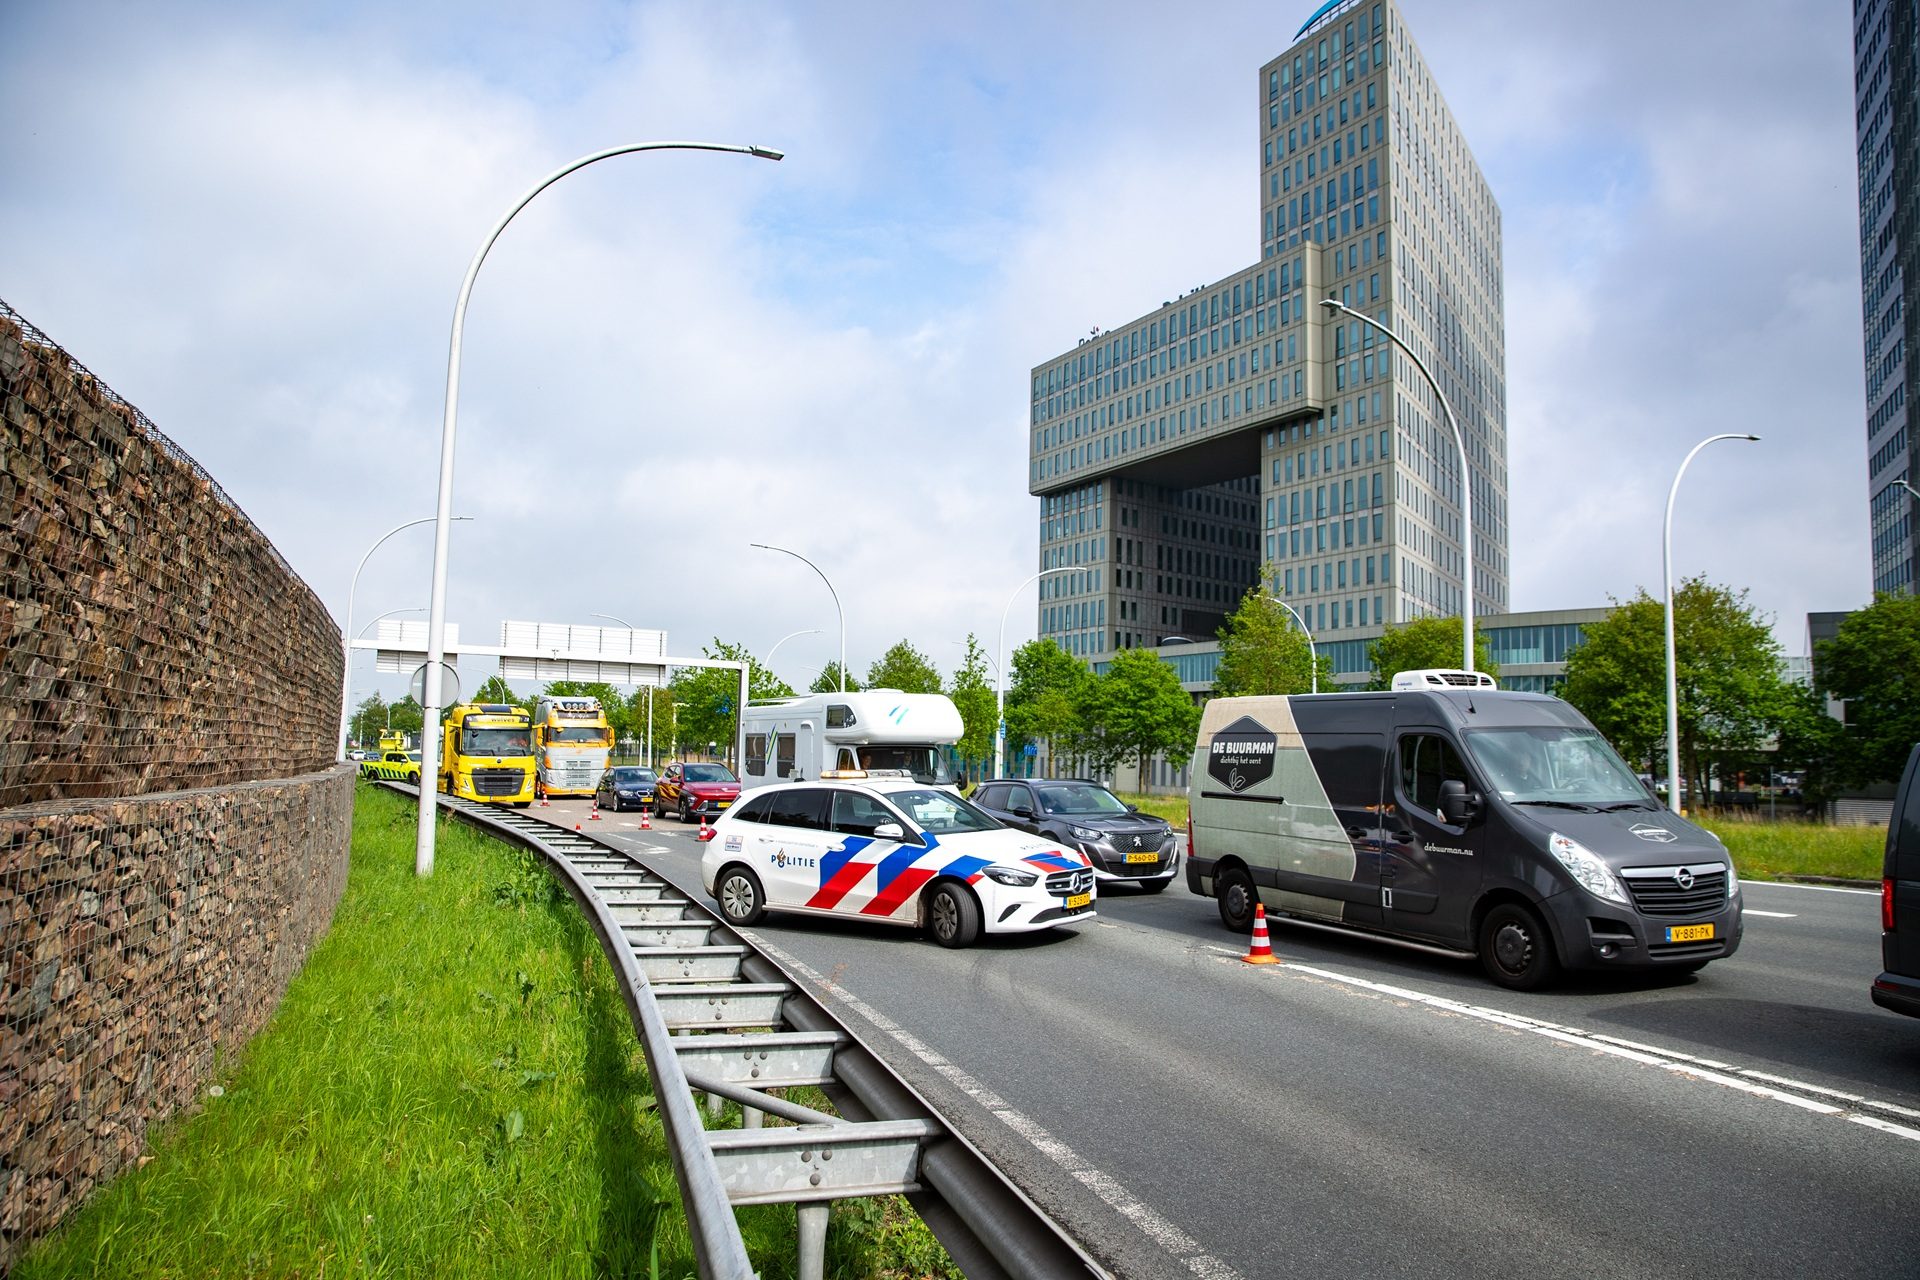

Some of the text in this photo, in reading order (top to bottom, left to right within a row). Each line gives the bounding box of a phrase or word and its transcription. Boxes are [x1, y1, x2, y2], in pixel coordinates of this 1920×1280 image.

[1212, 742, 1274, 755] DE BUURMAN
[1240, 755, 1248, 764] het
[1424, 842, 1473, 856] debuurman.nu
[771, 852, 815, 868] POLITIE
[1128, 854, 1156, 862] P-560-DS
[1674, 927, 1710, 939] V-881-PK
